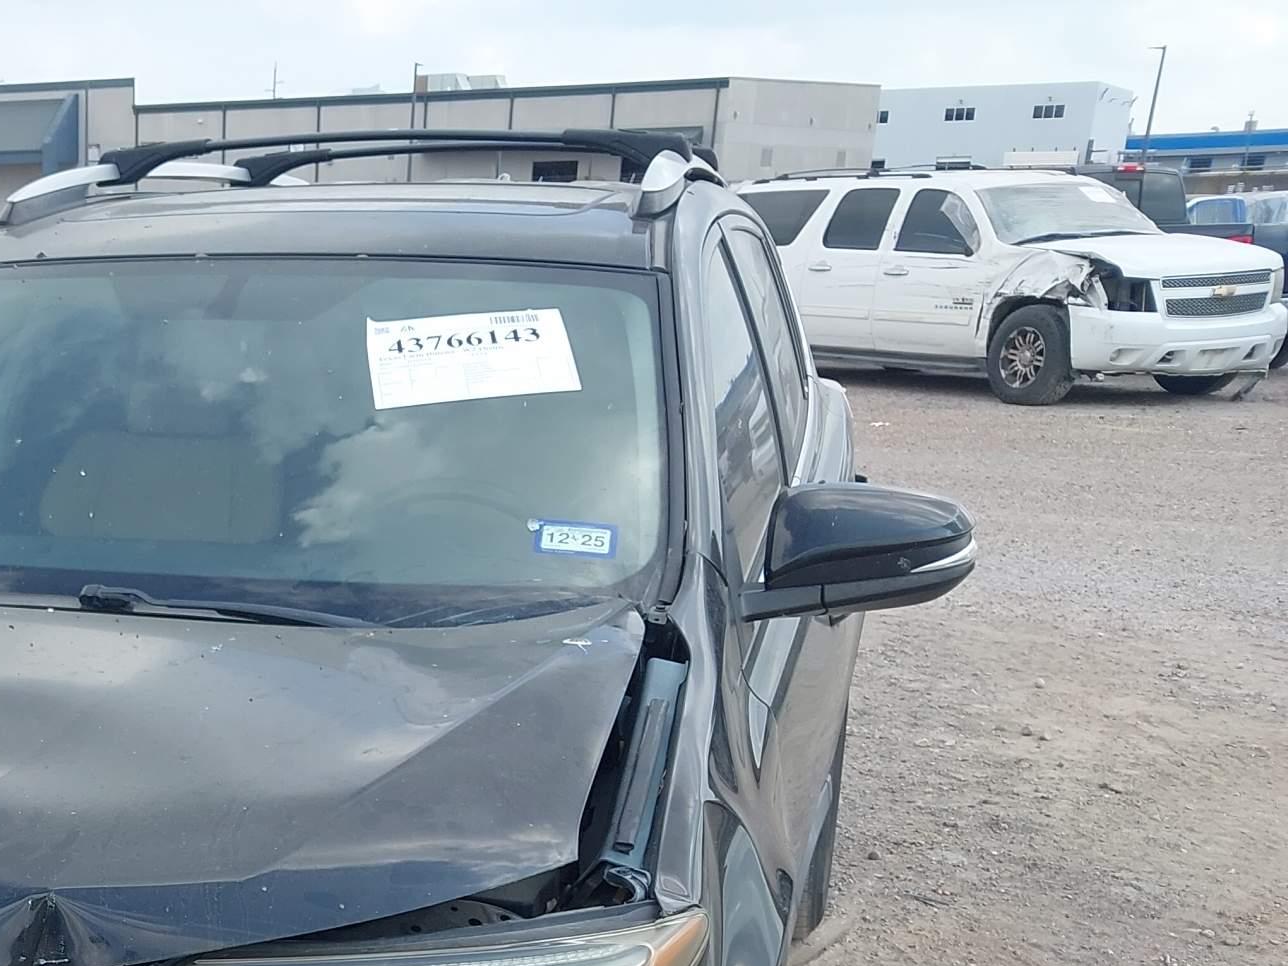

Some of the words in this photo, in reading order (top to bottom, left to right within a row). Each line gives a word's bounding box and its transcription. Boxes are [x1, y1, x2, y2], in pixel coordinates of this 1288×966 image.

[388, 327, 541, 354] 43766143
[546, 532, 570, 545] 12
[580, 534, 606, 548] 25
